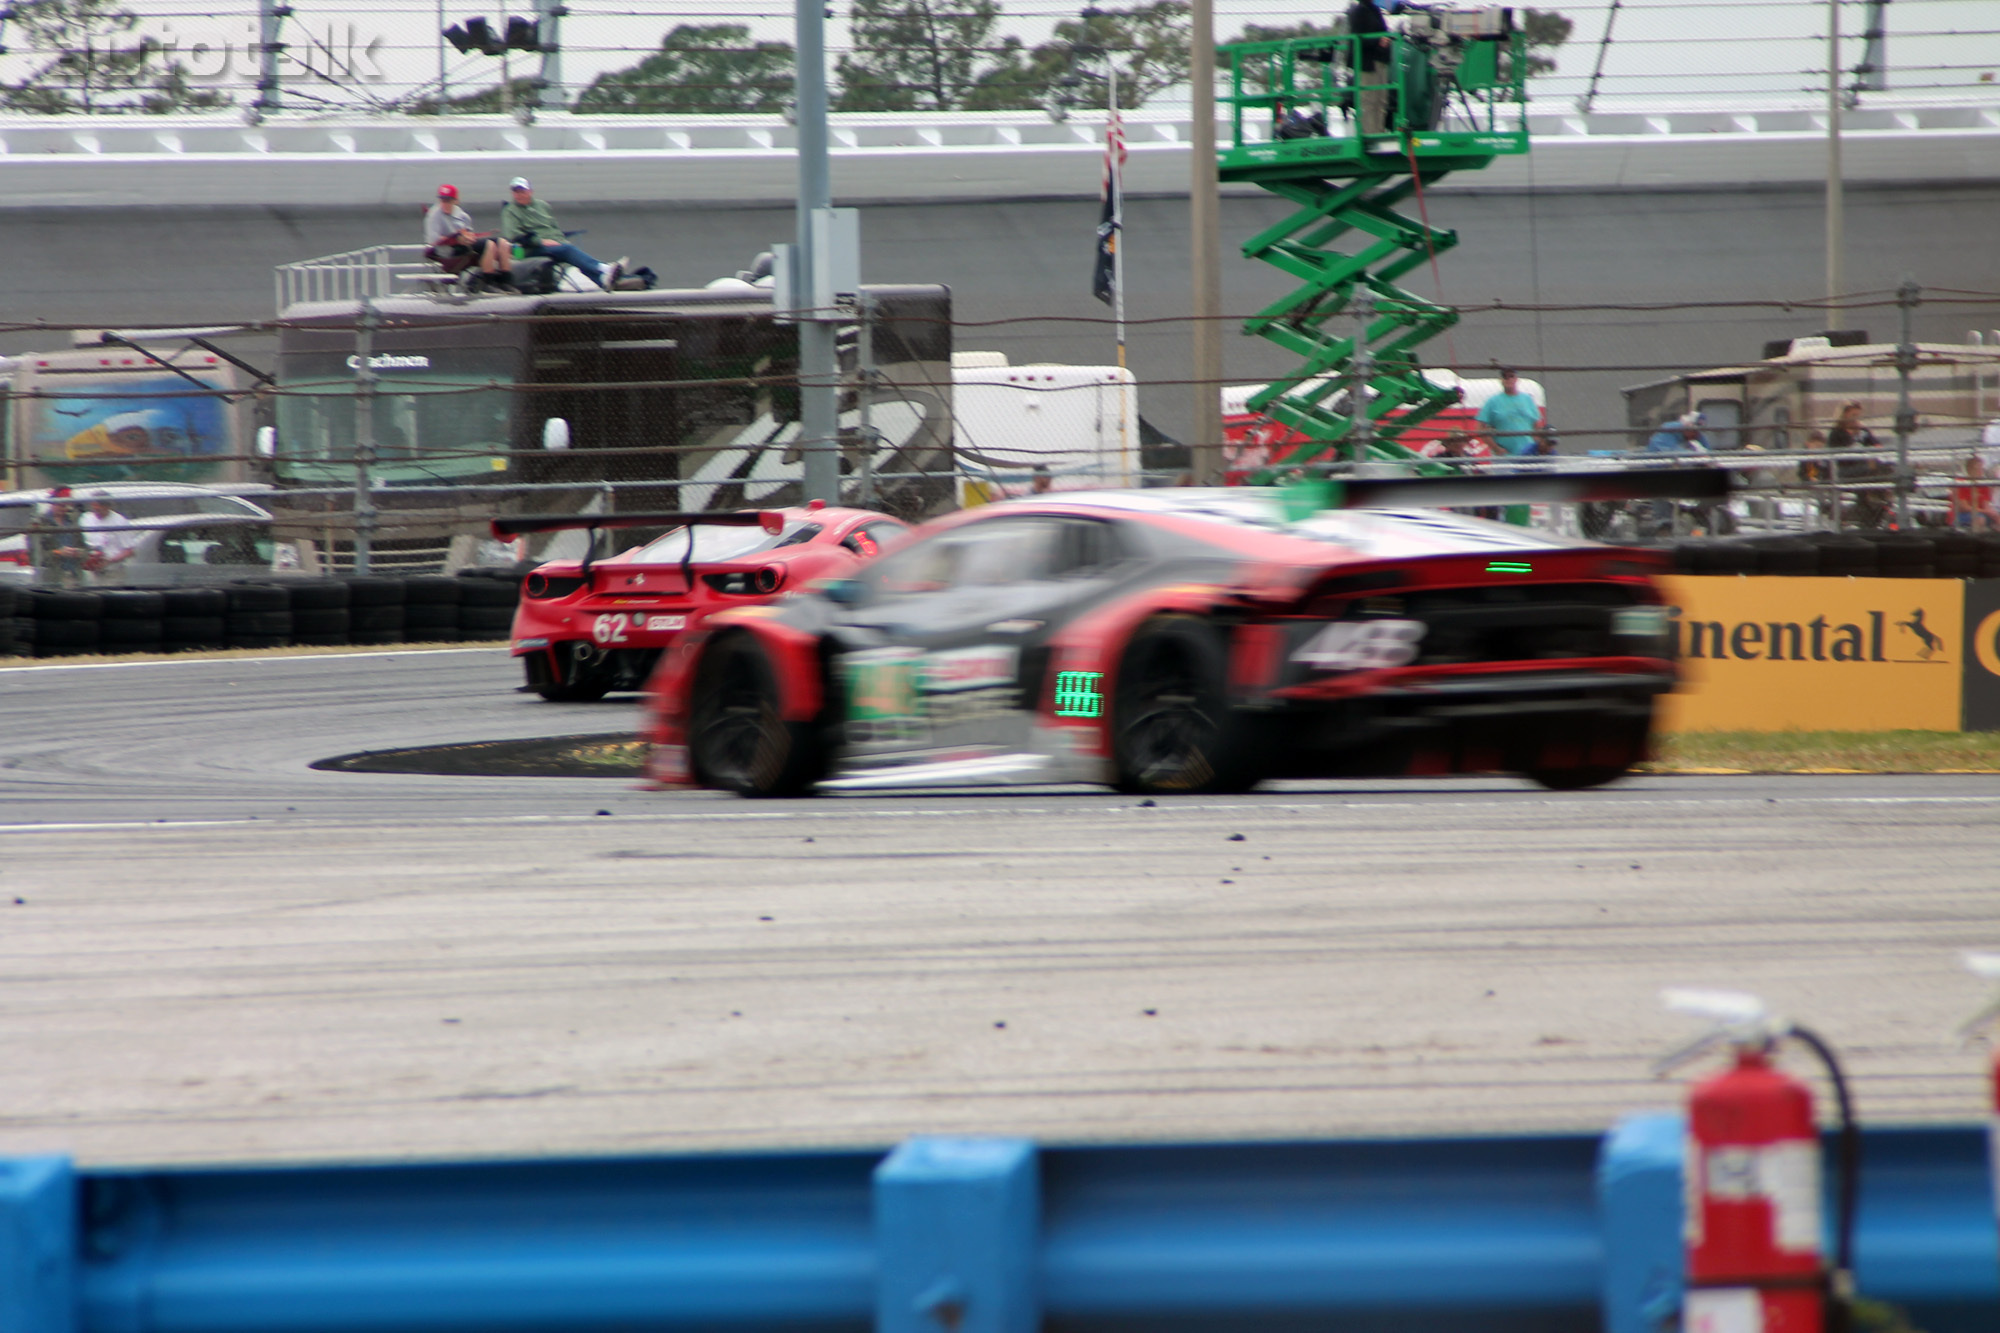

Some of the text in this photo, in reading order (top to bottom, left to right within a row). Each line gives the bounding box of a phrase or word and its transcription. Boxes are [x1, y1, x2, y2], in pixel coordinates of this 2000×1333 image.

[346, 352, 430, 369] Cachmen
[592, 612, 629, 644] 62
[1667, 606, 1888, 662] inental
